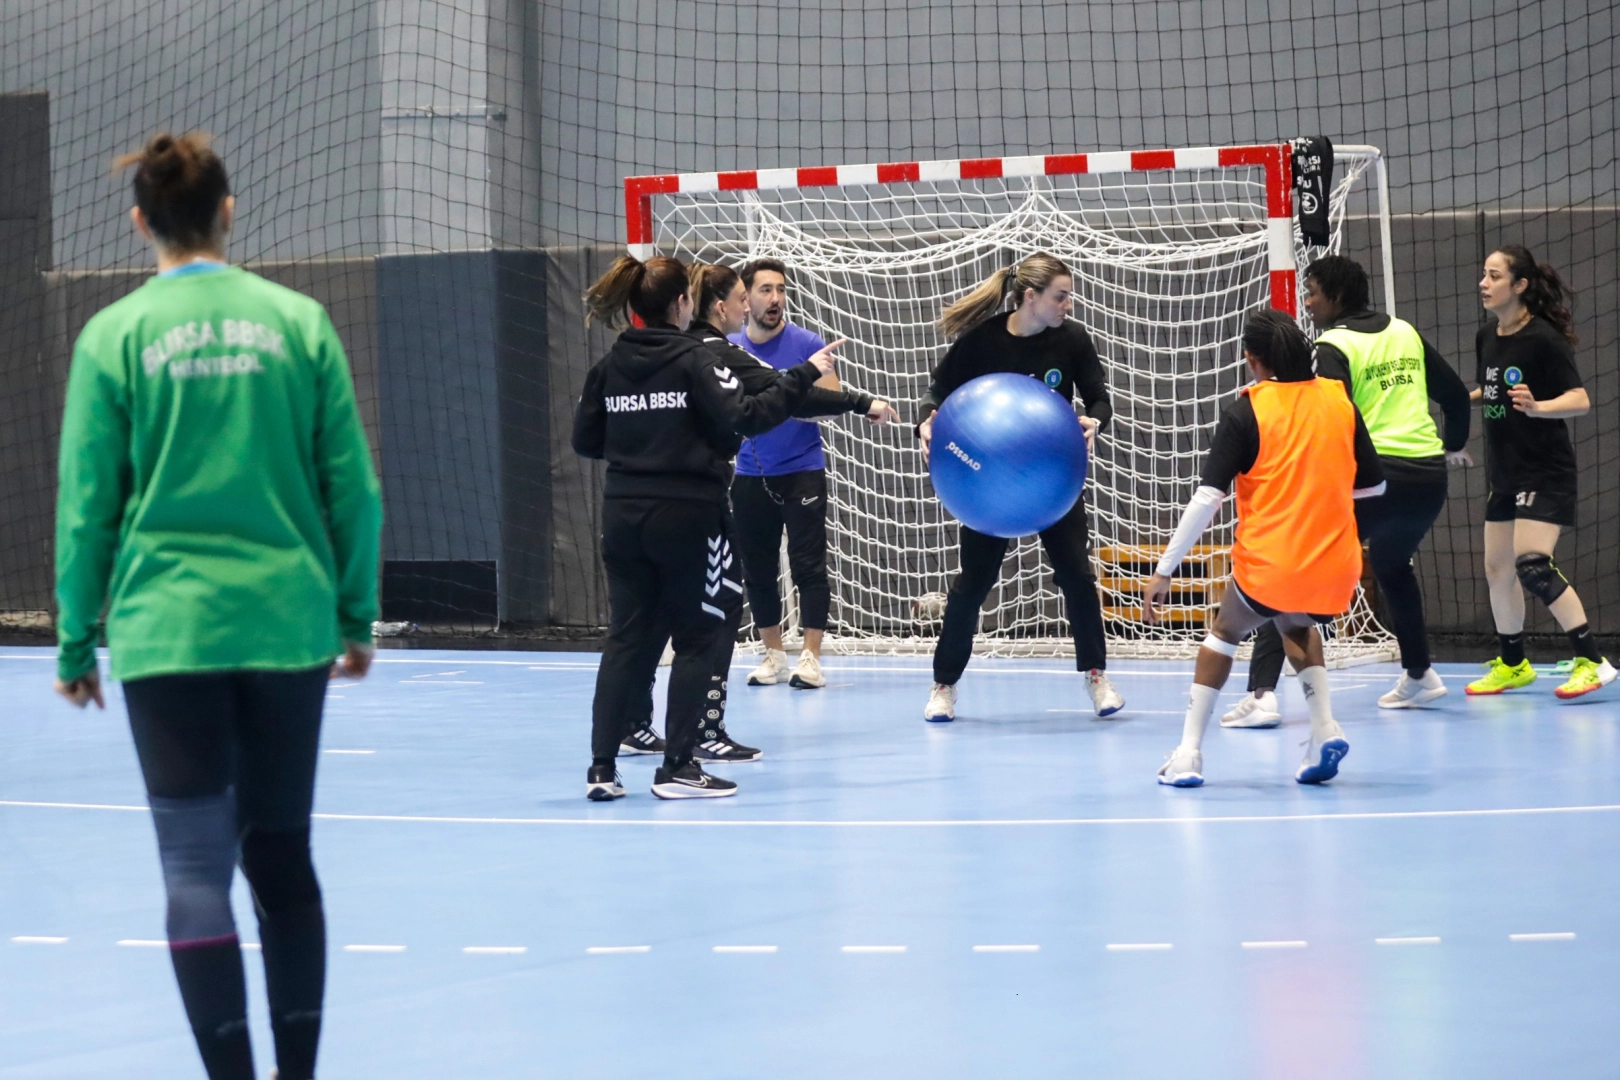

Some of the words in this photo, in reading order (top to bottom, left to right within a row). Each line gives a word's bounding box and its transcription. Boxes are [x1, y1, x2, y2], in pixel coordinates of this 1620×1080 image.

[140, 320, 218, 377] BURSA
[1486, 366, 1499, 381] WE
[1380, 374, 1414, 391] BURSA
[1483, 385, 1499, 400] ARE
[604, 393, 648, 412] BURSA
[649, 391, 687, 409] BBSK
